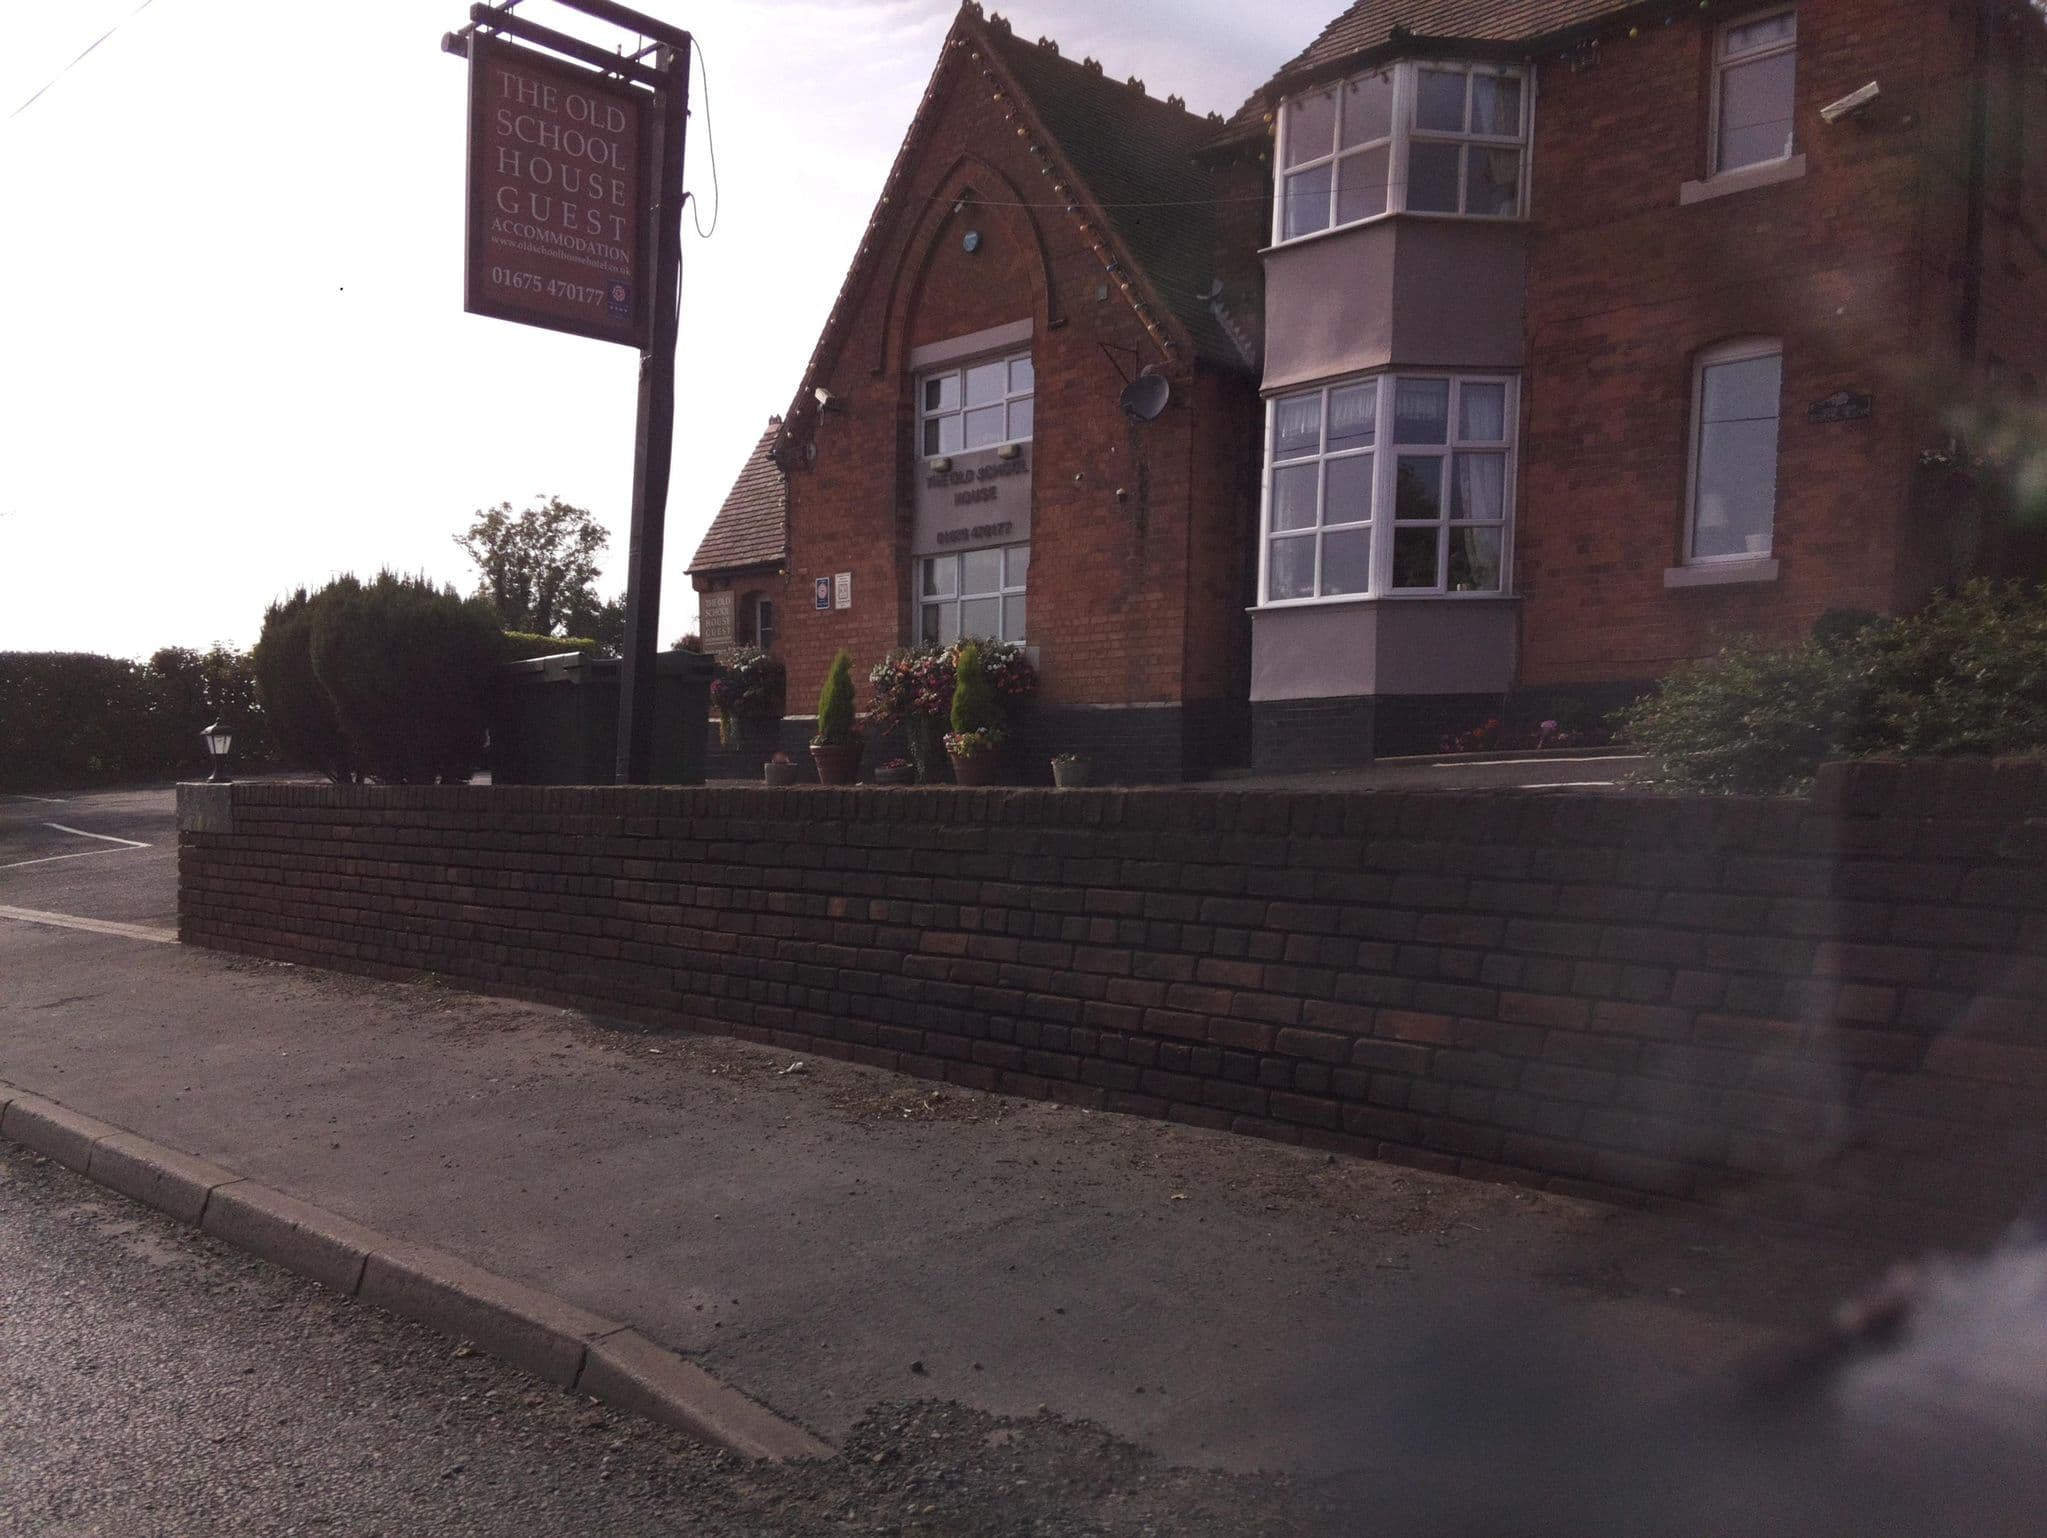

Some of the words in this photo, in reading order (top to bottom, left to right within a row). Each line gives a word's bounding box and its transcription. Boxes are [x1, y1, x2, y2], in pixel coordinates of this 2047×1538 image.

[498, 71, 558, 113] THE
[566, 94, 626, 133] OLD
[497, 108, 626, 171] SCHOOL
[497, 146, 626, 206] HOUSE
[491, 217, 630, 264] ACCOMMODATION
[497, 186, 626, 241] GUEST
[492, 266, 543, 292] 01675
[547, 279, 604, 306] 470177
